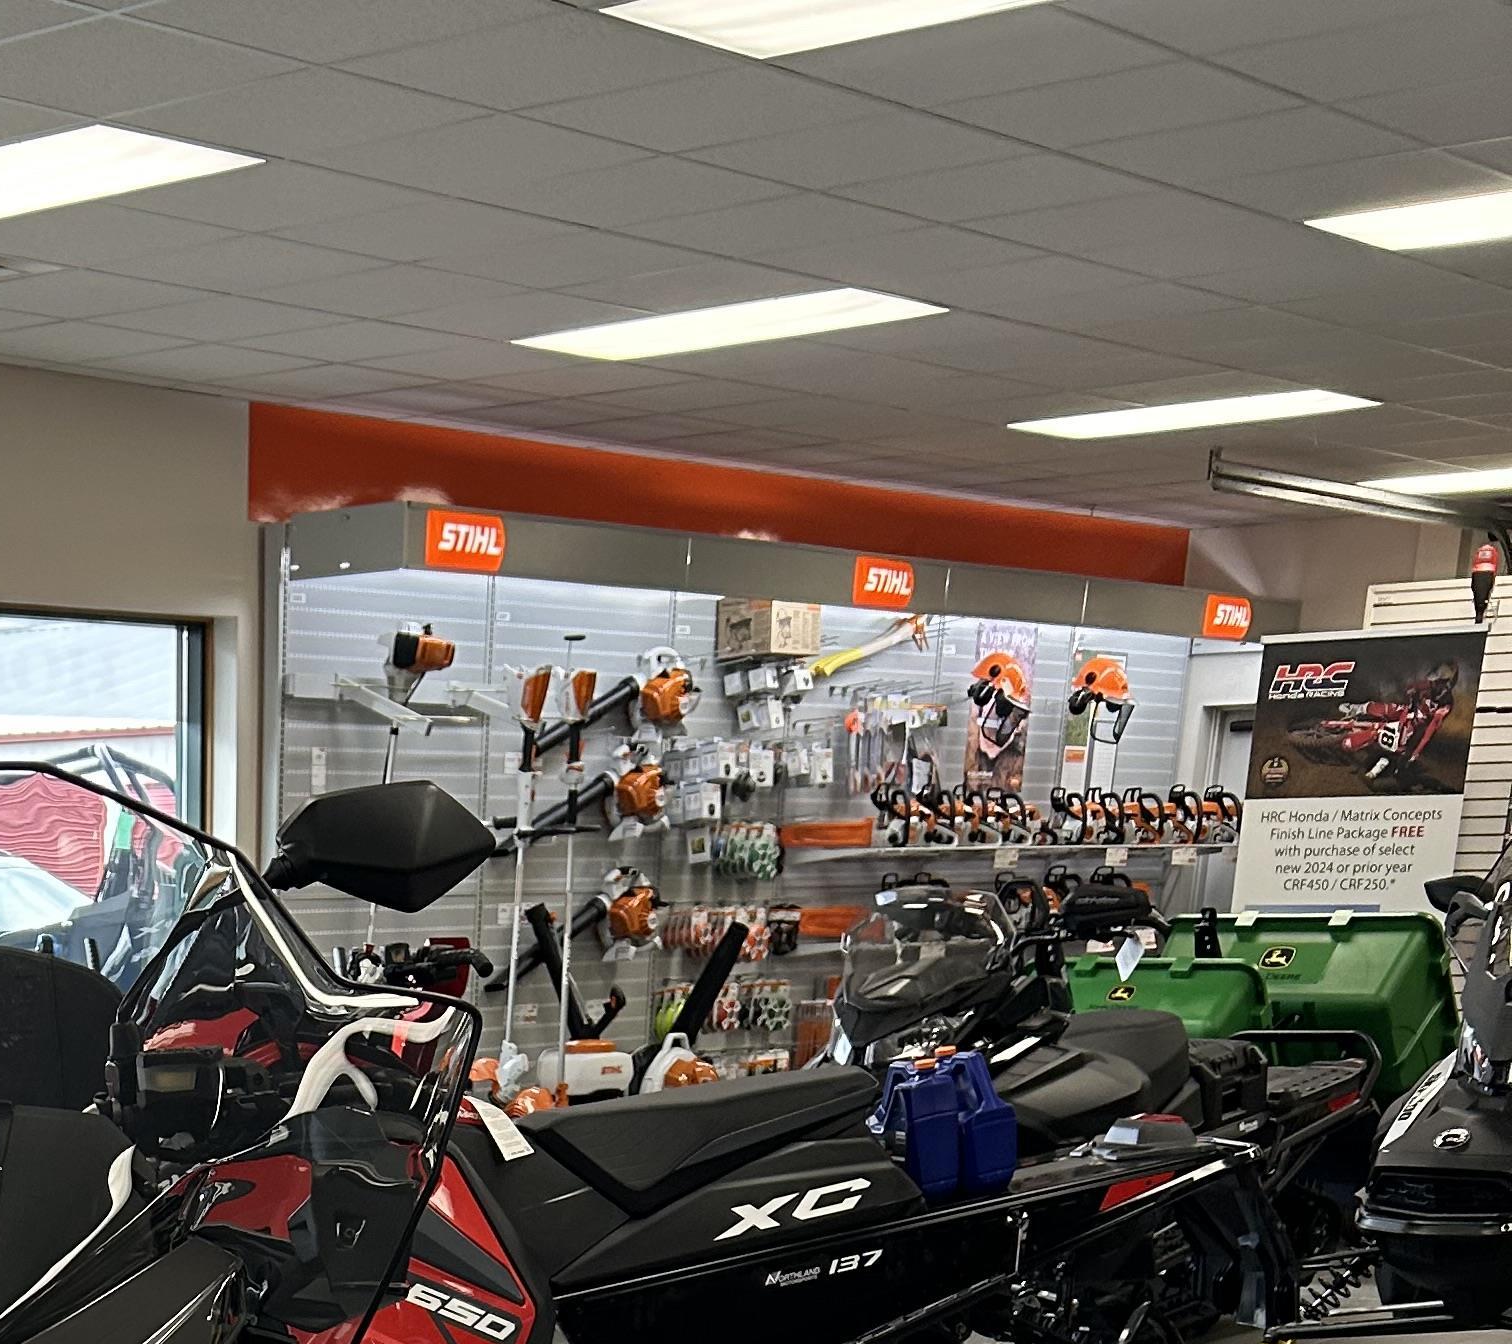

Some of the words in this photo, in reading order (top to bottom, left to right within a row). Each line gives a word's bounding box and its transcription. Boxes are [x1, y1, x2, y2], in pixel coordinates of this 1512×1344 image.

[438, 522, 504, 556] STIHL
[864, 567, 912, 596] STIHL
[1213, 604, 1249, 628] STIHL
[1269, 661, 1356, 694] HRC
[1261, 810, 1285, 823] HRC
[1289, 809, 1329, 822] Honda
[1332, 809, 1339, 822] /
[1340, 808, 1380, 821] Matrix
[1383, 807, 1443, 824] Concepts
[1270, 827, 1305, 840] Finish
[1308, 826, 1334, 839] Line
[1337, 826, 1388, 841] Package
[1391, 825, 1425, 838] FREE
[1275, 844, 1301, 857] with
[1303, 843, 1360, 859] purchase
[1362, 843, 1377, 857] of
[1378, 842, 1416, 856] select
[1275, 864, 1301, 874] new
[1304, 862, 1334, 874] 2024
[1337, 864, 1350, 874] or
[1352, 861, 1383, 875] prior
[1385, 863, 1414, 876] year
[1283, 878, 1330, 891] CRF450
[1331, 878, 1337, 891] /
[713, 1177, 872, 1242] XC
[828, 1249, 884, 1275] 137
[405, 1283, 516, 1340] 650
